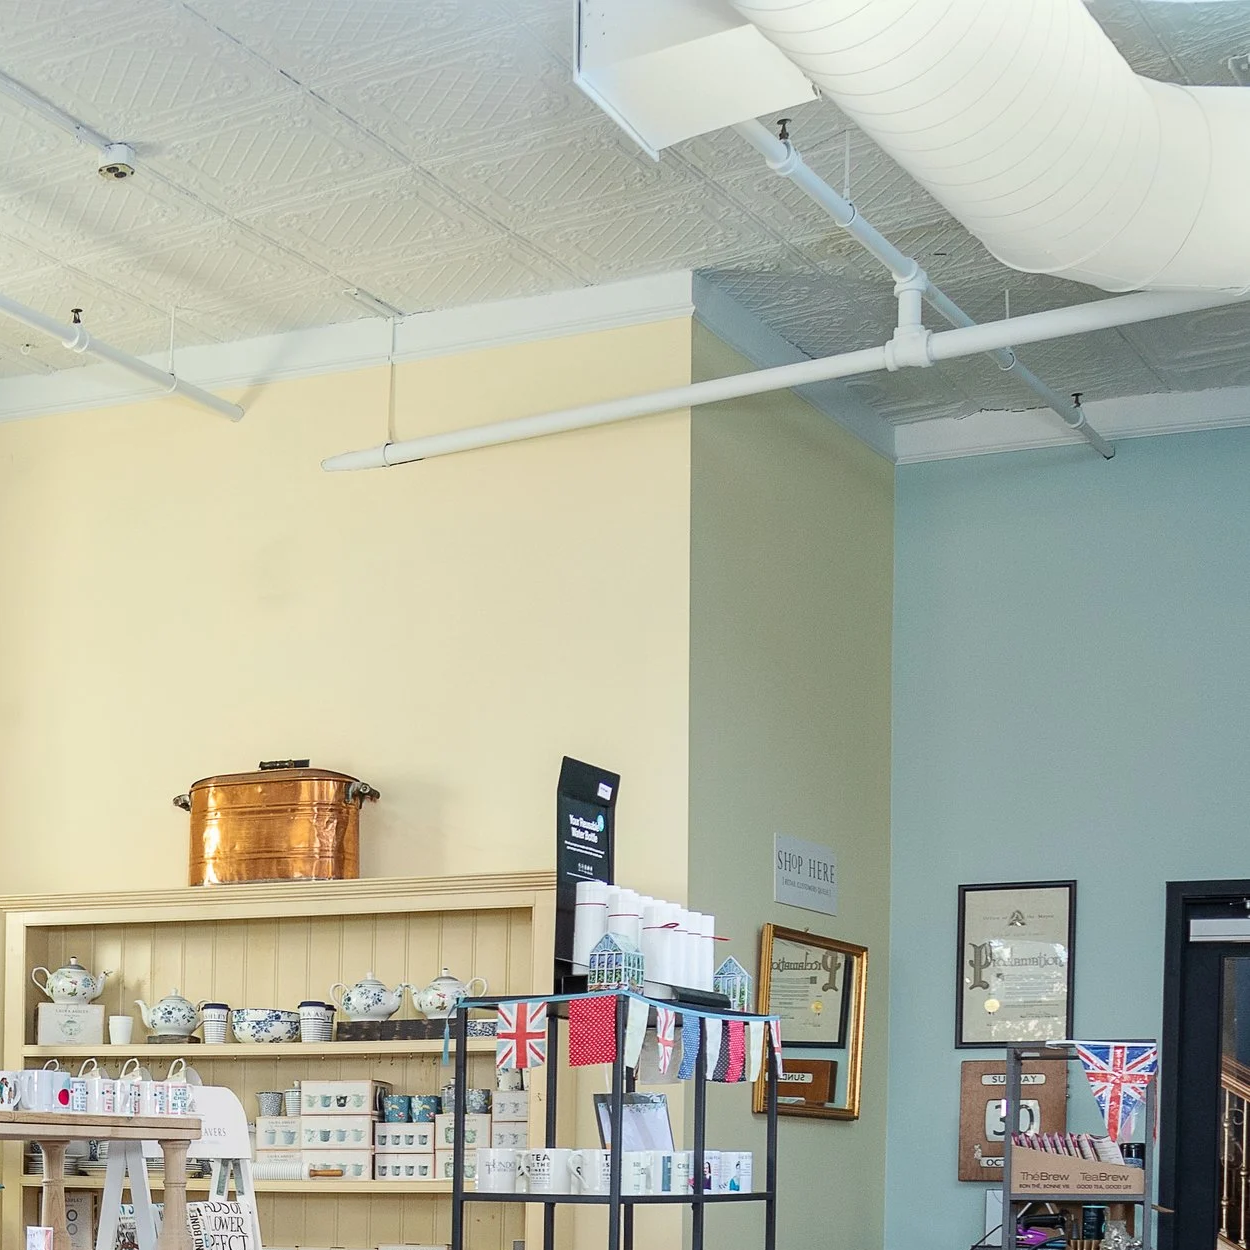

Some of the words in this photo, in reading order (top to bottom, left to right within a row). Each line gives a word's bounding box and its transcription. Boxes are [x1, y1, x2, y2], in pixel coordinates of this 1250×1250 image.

[571, 826, 585, 839] Water
[584, 830, 598, 843] Bottle
[777, 850, 803, 875] SHOP
[808, 858, 835, 884] HERE
[968, 941, 1065, 991] Proclamation
[1020, 1171, 1070, 1182] ThéBrew
[1080, 1172, 1129, 1182] TeaBrew
